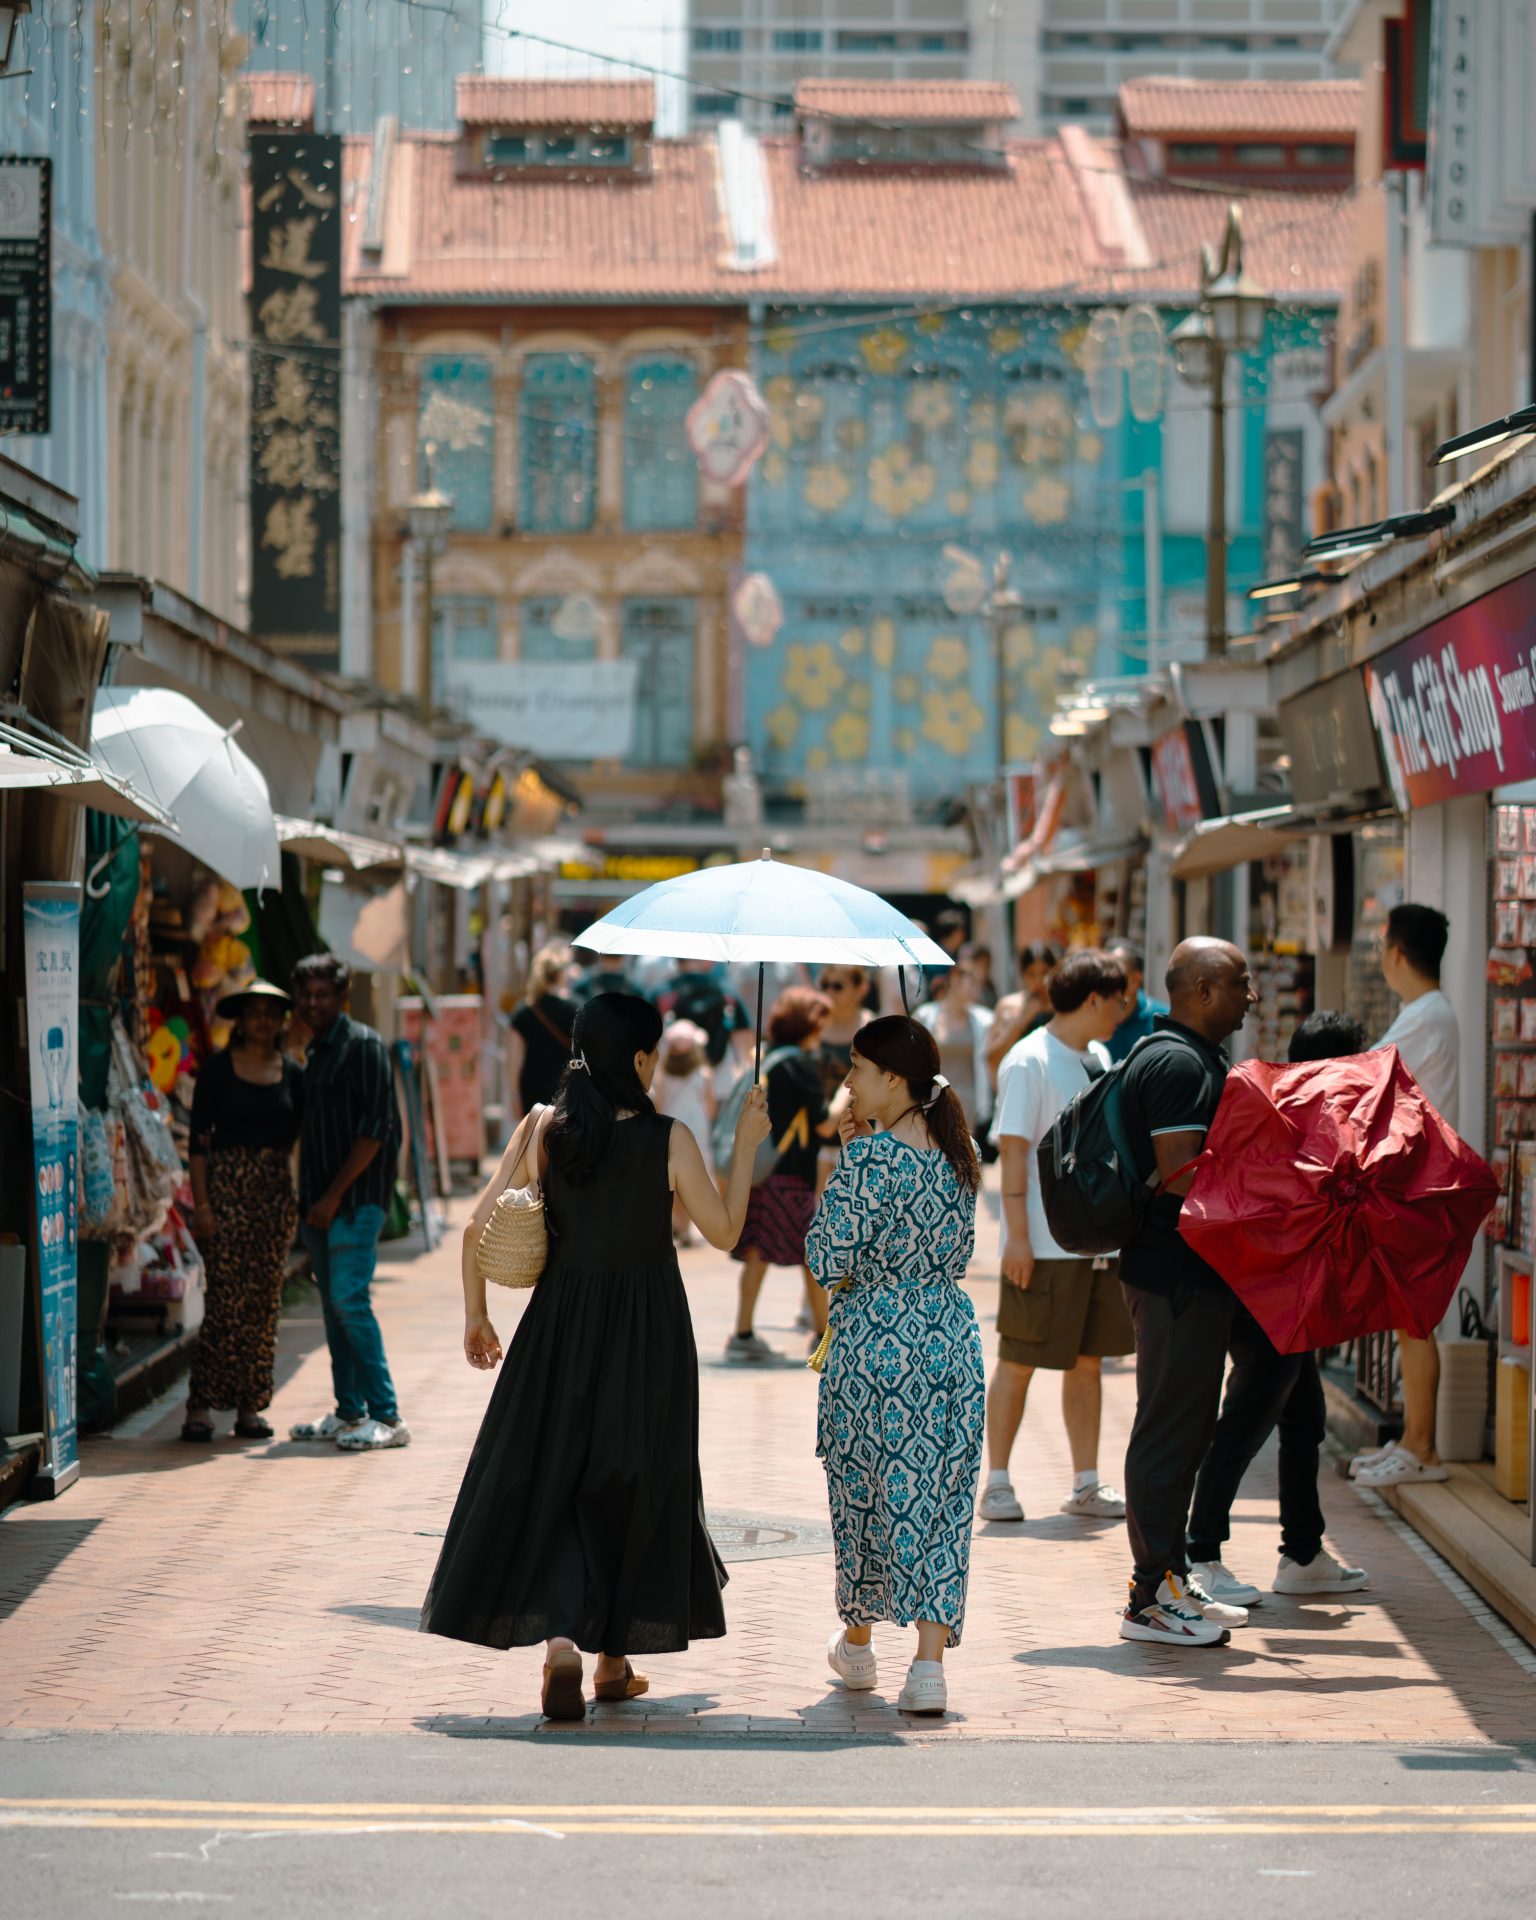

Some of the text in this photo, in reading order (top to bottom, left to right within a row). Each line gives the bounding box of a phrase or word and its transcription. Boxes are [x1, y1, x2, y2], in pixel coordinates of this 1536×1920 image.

[1449, 14, 1470, 225] TATTOO
[1383, 669, 1428, 776] The
[1411, 653, 1460, 780] Gift
[1441, 641, 1505, 773] Shop
